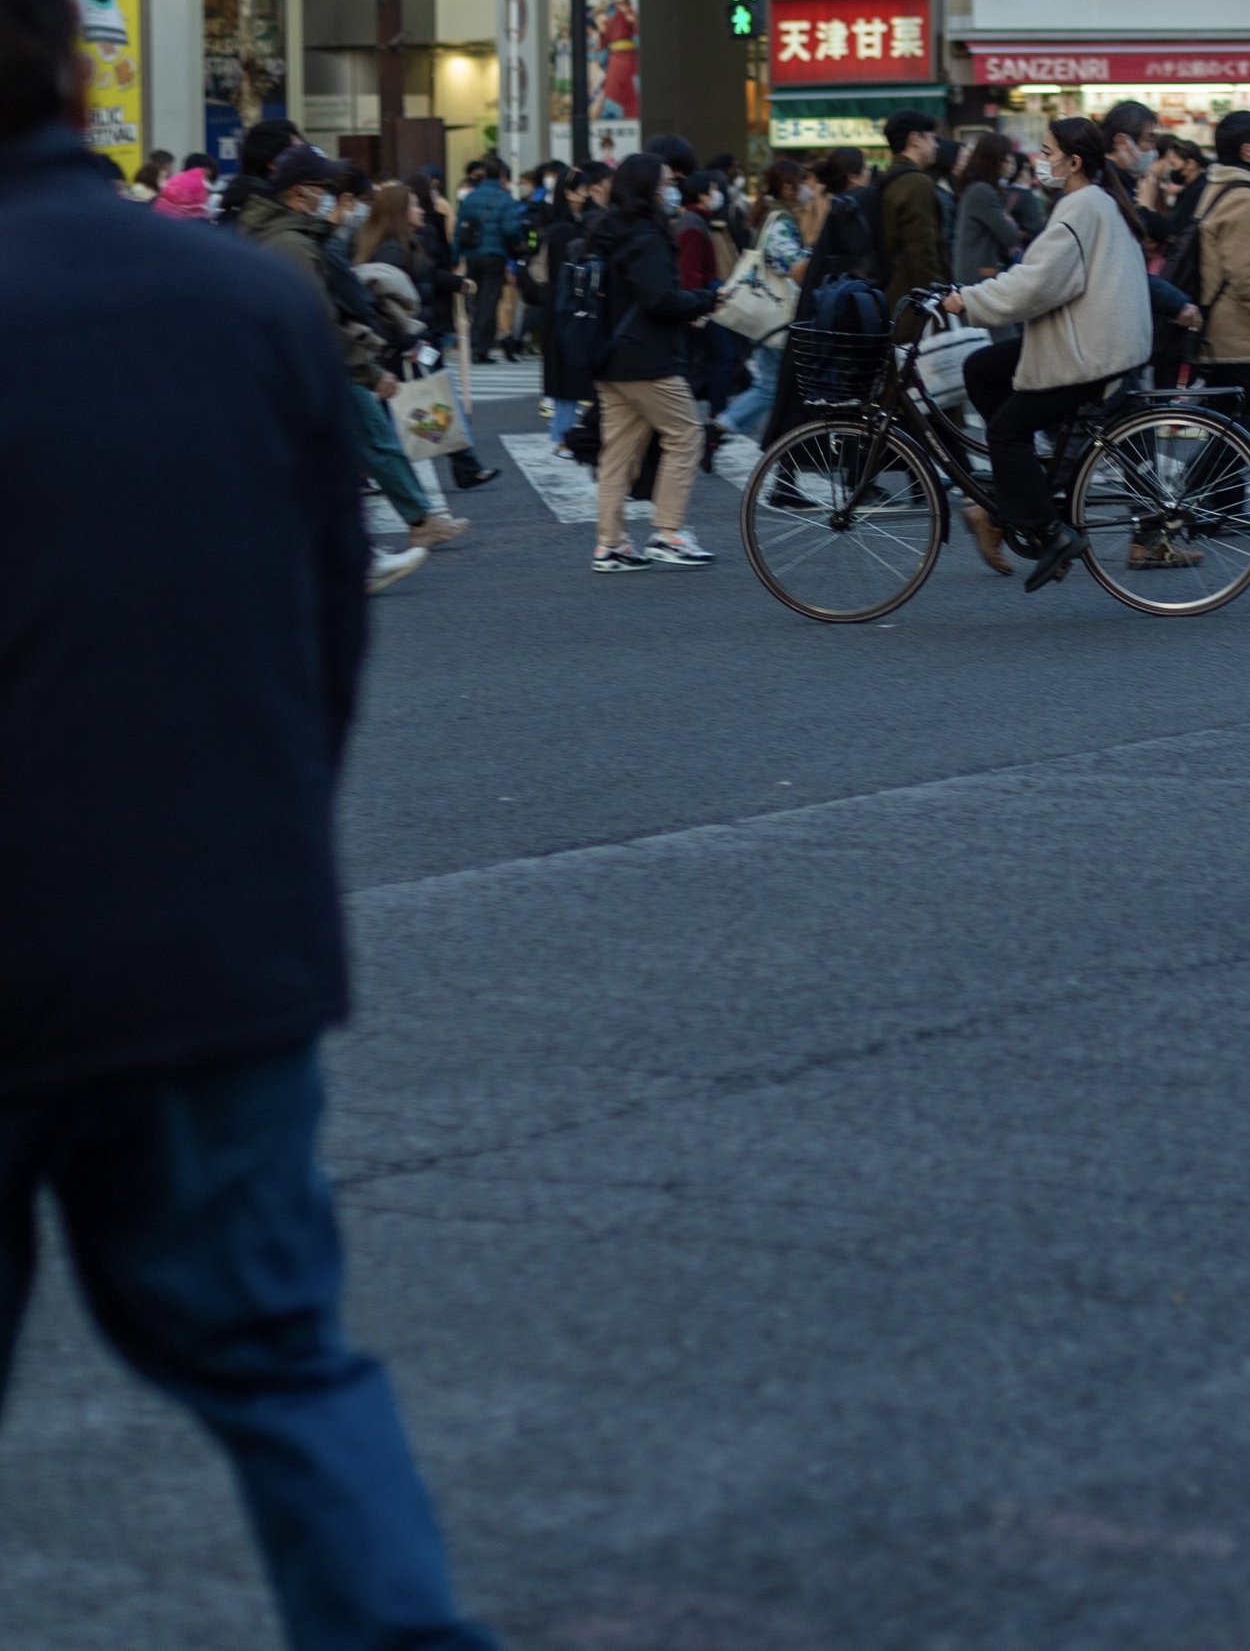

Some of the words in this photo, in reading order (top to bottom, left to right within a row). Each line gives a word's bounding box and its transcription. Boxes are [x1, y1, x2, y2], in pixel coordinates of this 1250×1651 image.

[777, 16, 925, 63] 天津甘栗
[985, 57, 1110, 81] SANZENRI
